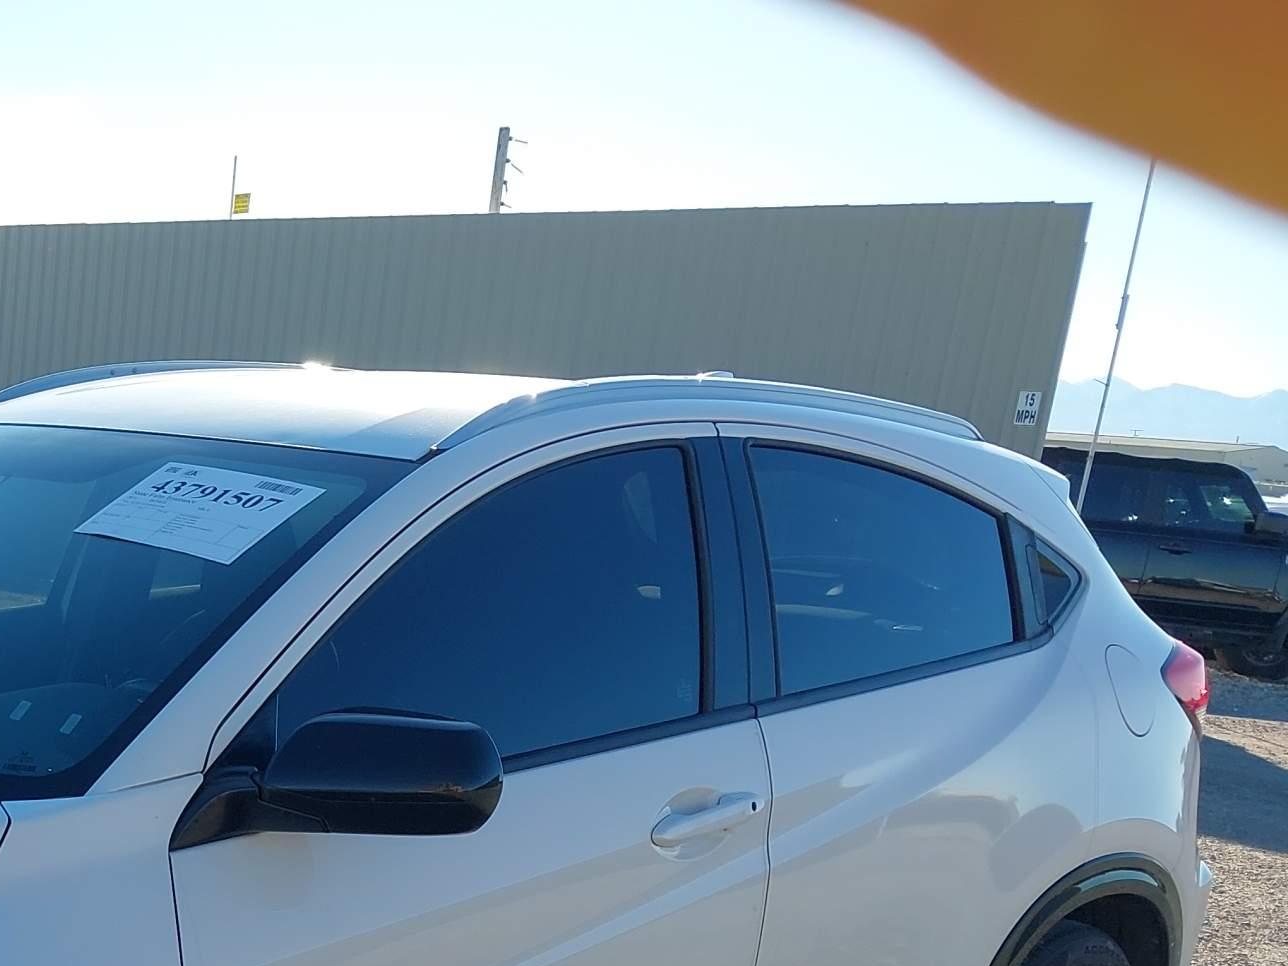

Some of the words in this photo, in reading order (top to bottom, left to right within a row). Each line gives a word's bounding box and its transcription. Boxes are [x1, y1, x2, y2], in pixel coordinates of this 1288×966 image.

[1024, 393, 1036, 407] 15
[1015, 409, 1037, 424] MPH
[151, 480, 284, 512] 43791507
